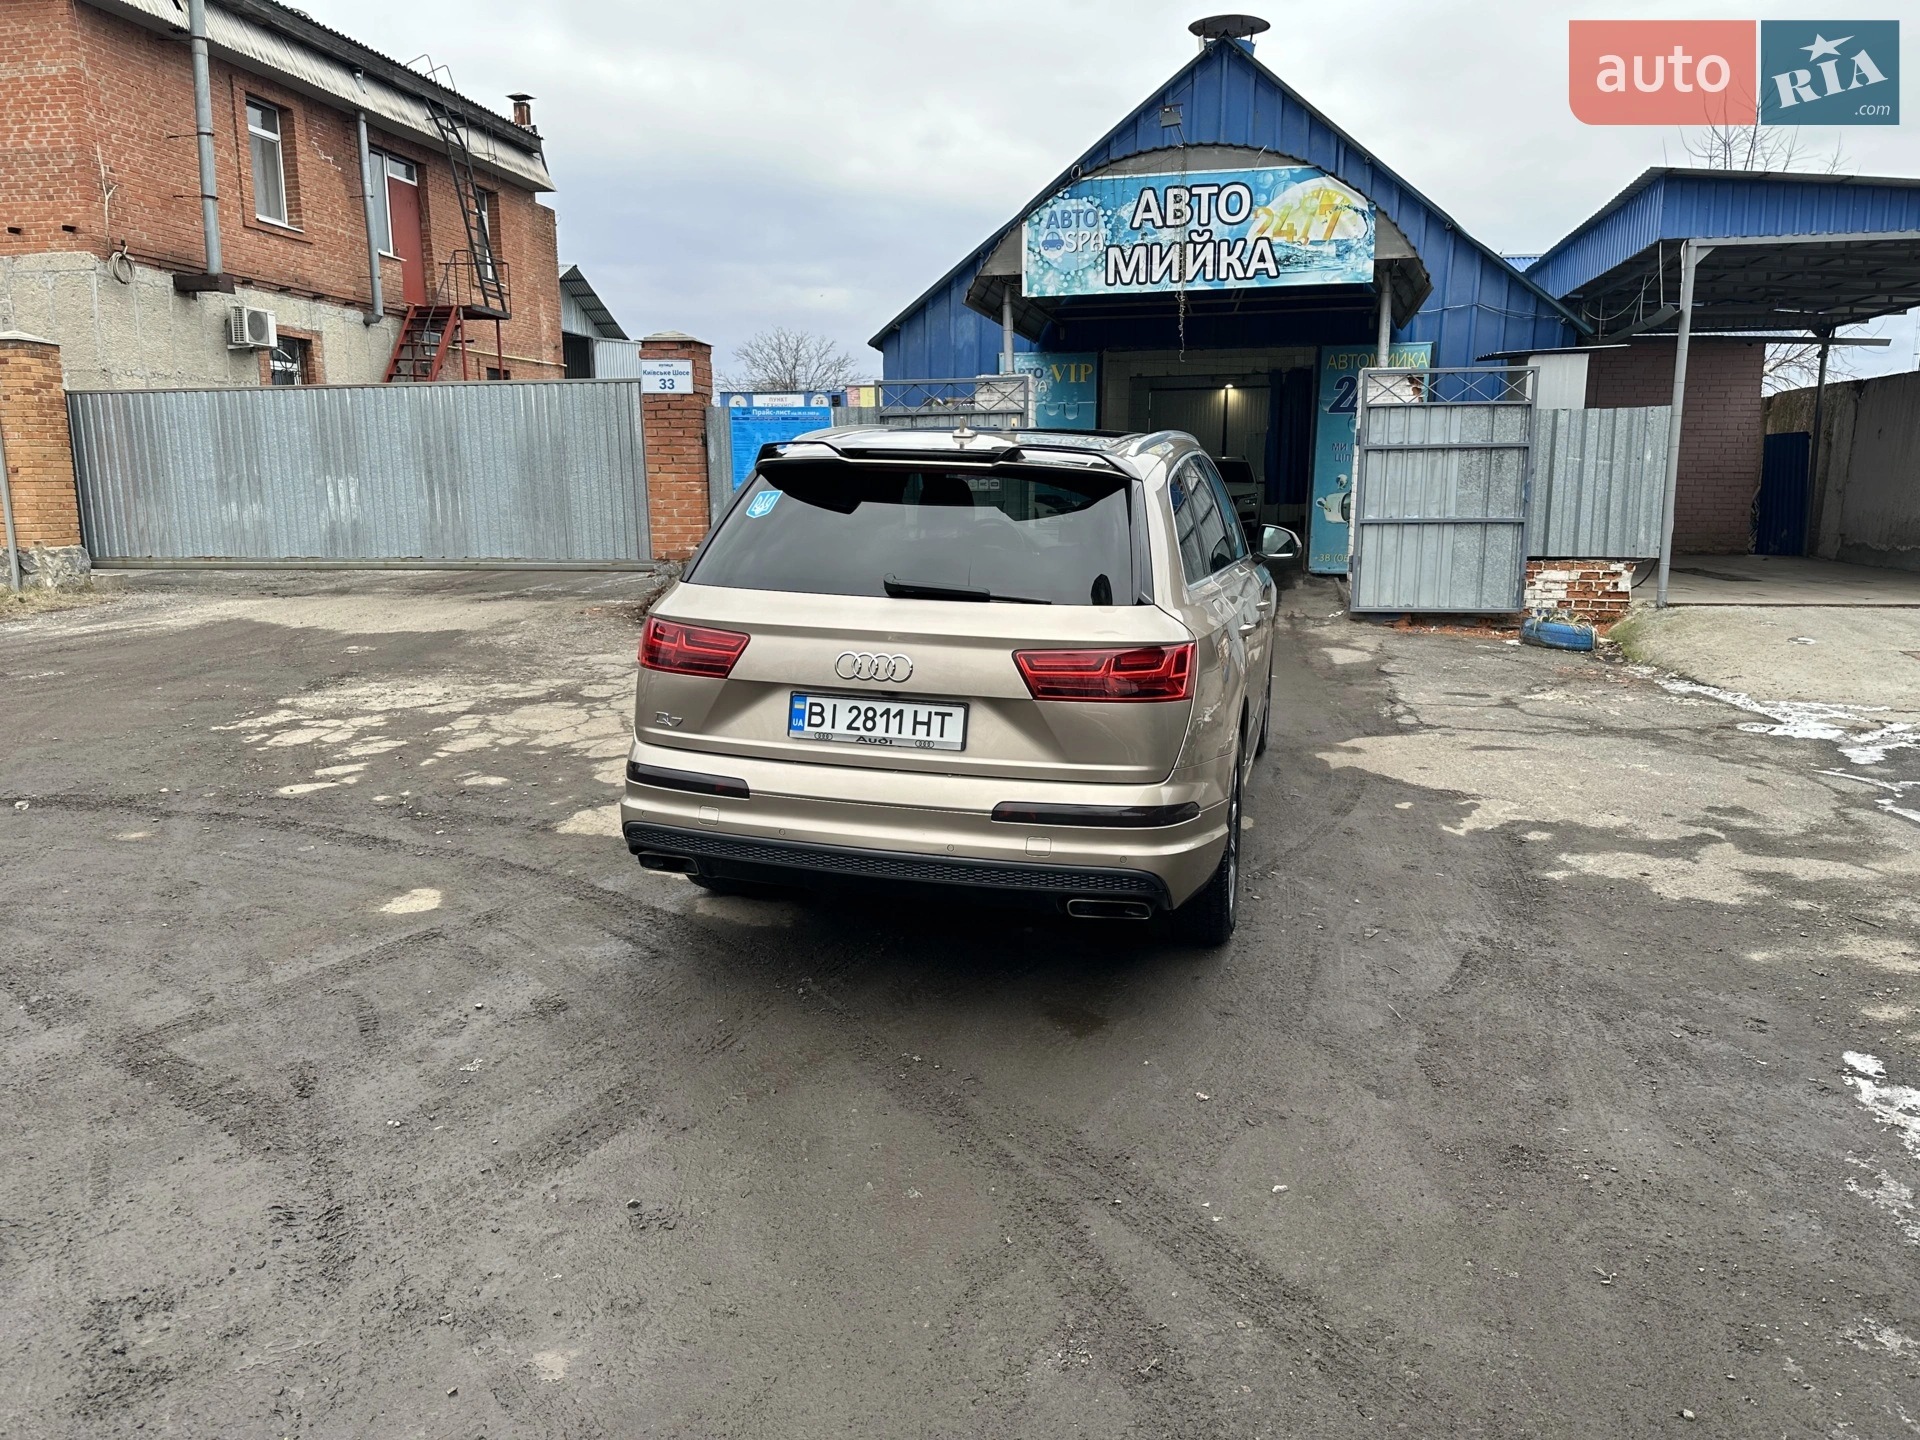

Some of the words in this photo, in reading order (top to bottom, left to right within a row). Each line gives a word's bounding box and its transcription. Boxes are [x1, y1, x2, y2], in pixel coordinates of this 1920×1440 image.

[1130, 181, 1252, 230] АВТО
[1046, 208, 1099, 230] АВТО
[1065, 231, 1105, 253] SPA
[1105, 230, 1280, 286] МИЙКА
[659, 378, 675, 390] 33
[1051, 363, 1094, 384] VIP
[752, 408, 791, 416] Прайс-лист
[655, 710, 684, 727] Q7
[792, 718, 804, 727] UA
[807, 702, 837, 729] BI
[846, 705, 904, 735] 2811
[911, 710, 954, 738] HT
[855, 735, 894, 745] Audi
